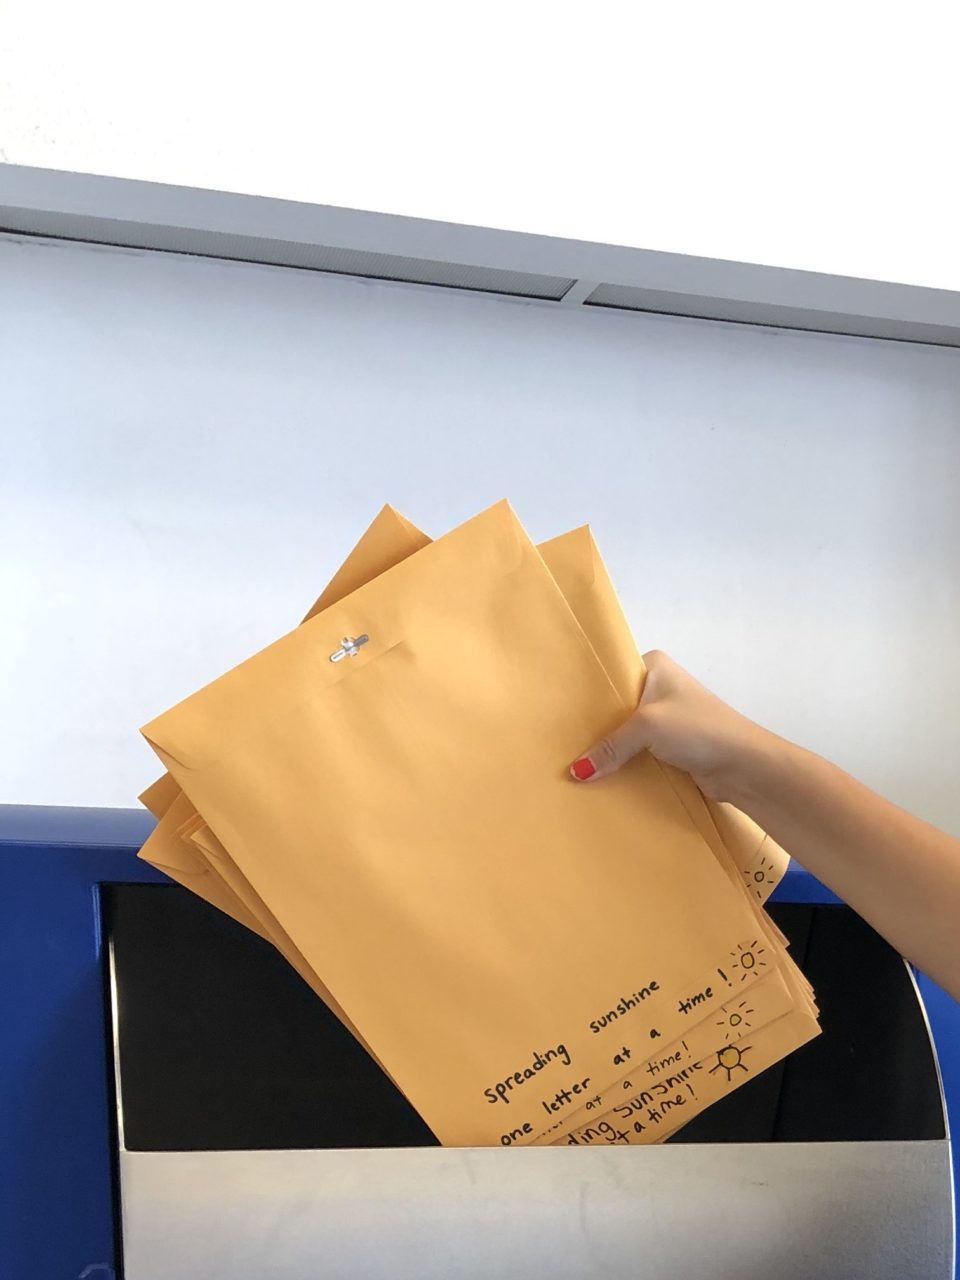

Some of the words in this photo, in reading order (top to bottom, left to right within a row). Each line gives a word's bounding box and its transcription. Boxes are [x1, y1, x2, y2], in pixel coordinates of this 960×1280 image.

[589, 978, 660, 1034] sunshine
[500, 1121, 533, 1147] one
[541, 1077, 591, 1115] letter
[613, 1047, 632, 1066] at
[649, 1028, 661, 1039] a
[677, 986, 714, 1016] time
[585, 1096, 602, 1110] at
